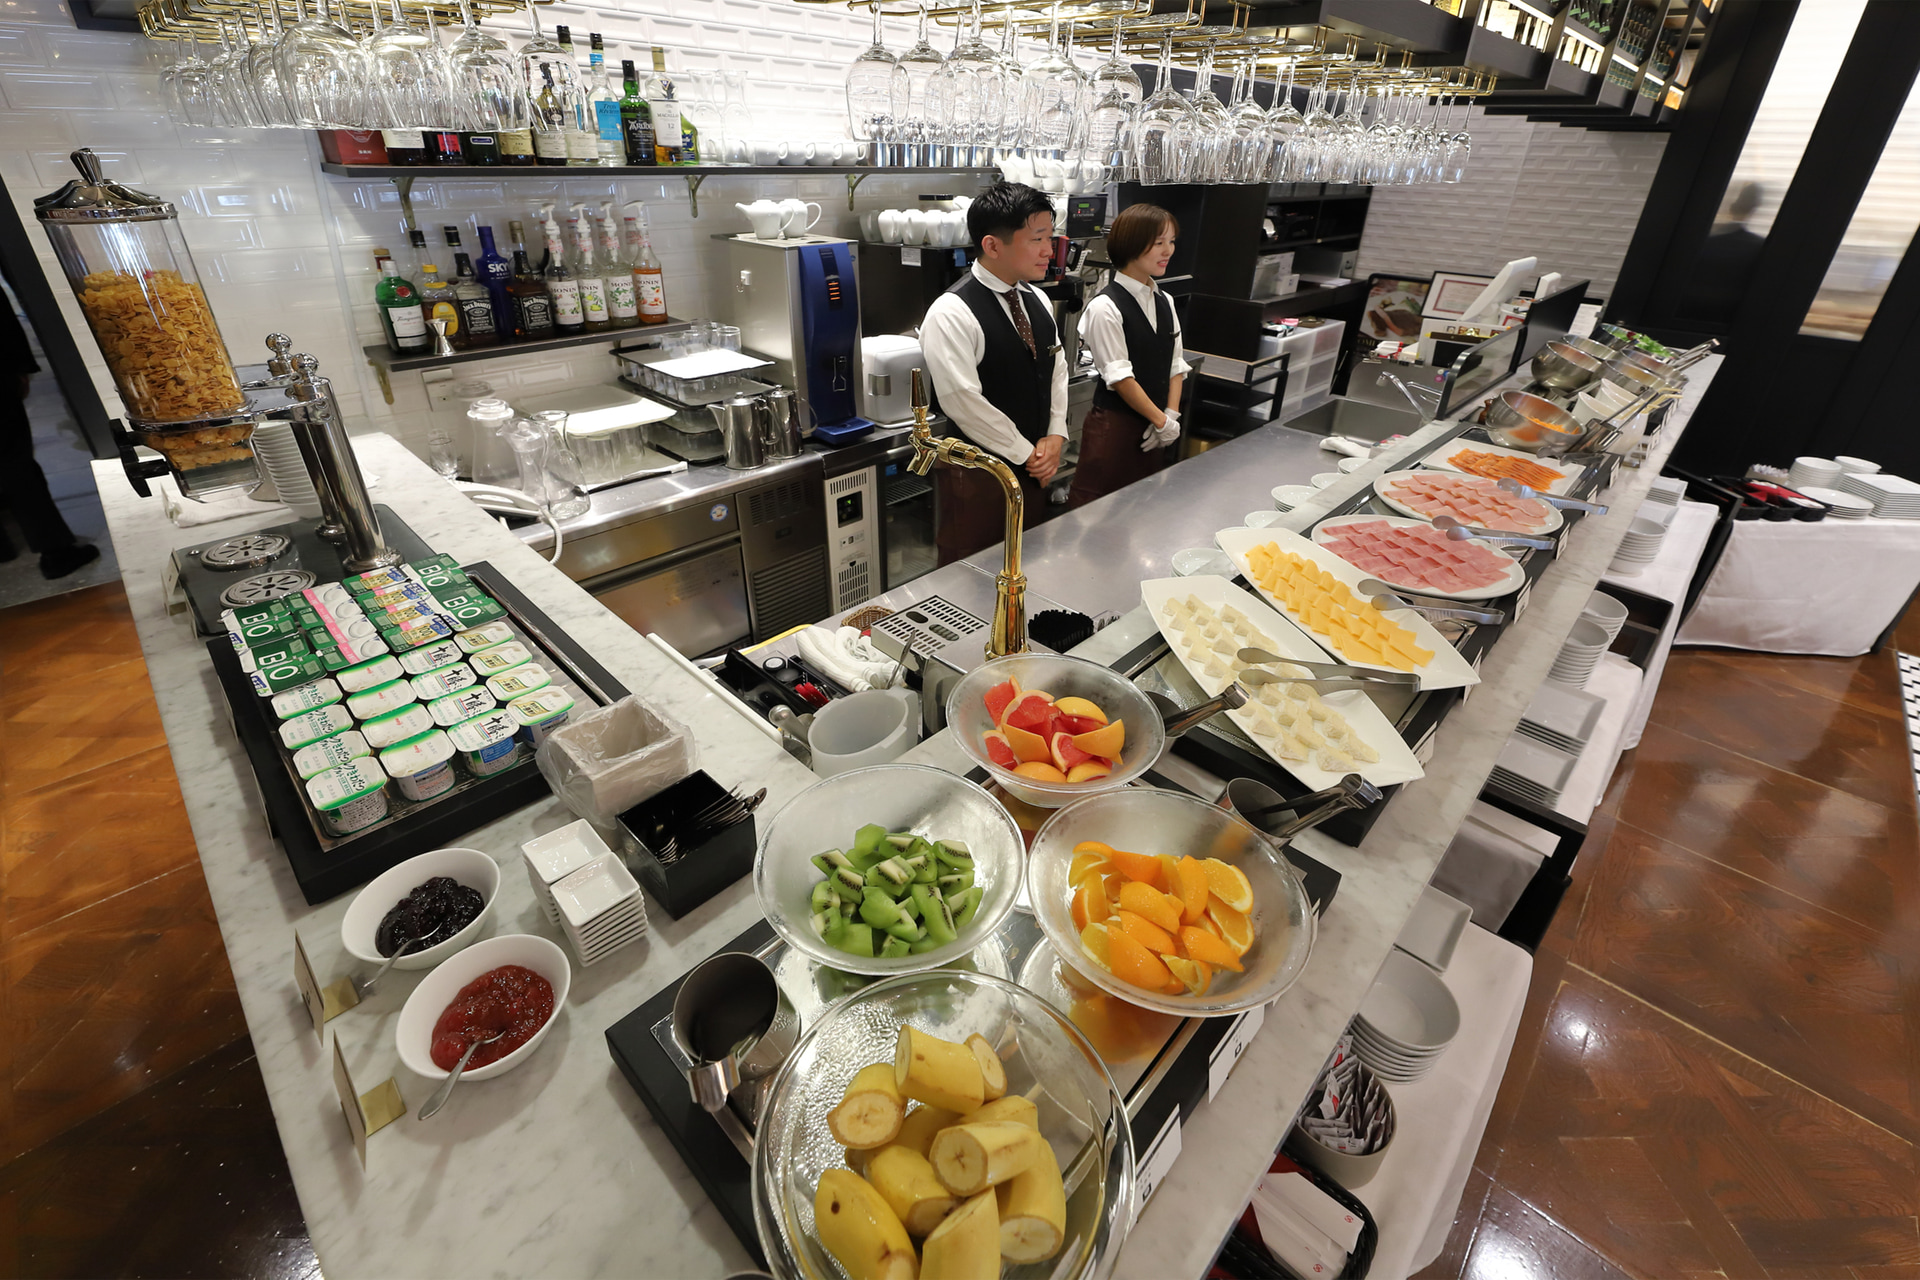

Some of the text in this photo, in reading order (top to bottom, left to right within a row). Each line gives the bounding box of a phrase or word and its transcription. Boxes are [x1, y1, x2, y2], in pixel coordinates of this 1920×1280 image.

[418, 564, 449, 587] BIO
[443, 595, 482, 619] BIO
[241, 612, 274, 637] BIO
[258, 651, 298, 680] BIO
